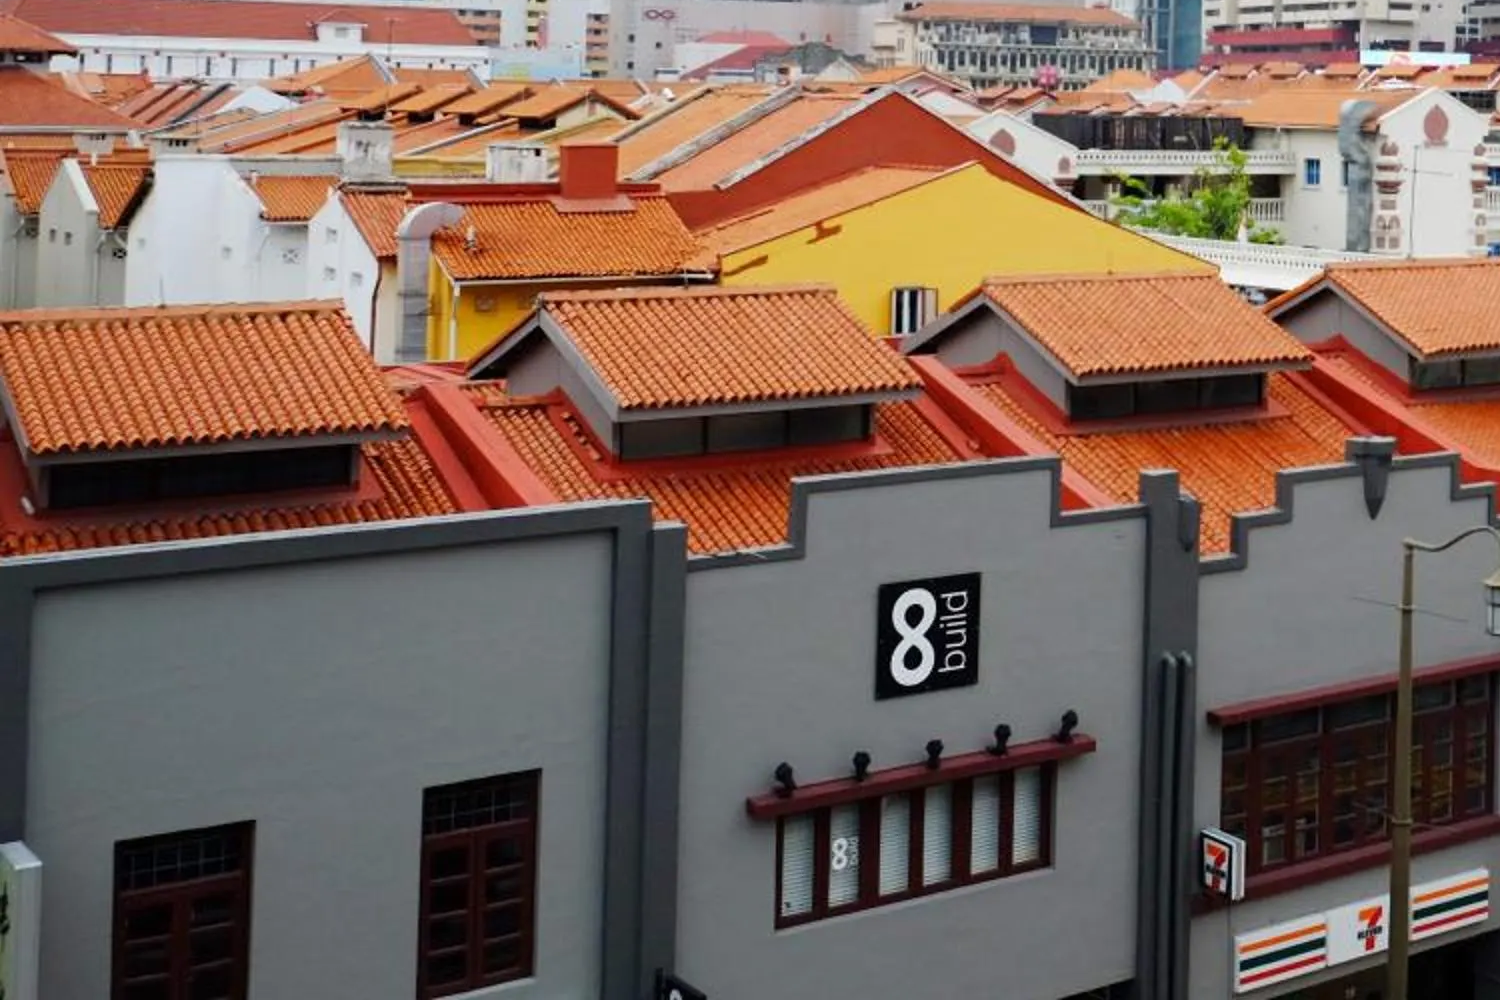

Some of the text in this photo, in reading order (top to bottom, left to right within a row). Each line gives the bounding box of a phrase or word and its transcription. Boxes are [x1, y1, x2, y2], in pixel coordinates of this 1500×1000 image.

[890, 587, 968, 686] 8 build
[1359, 905, 1382, 952] 7
